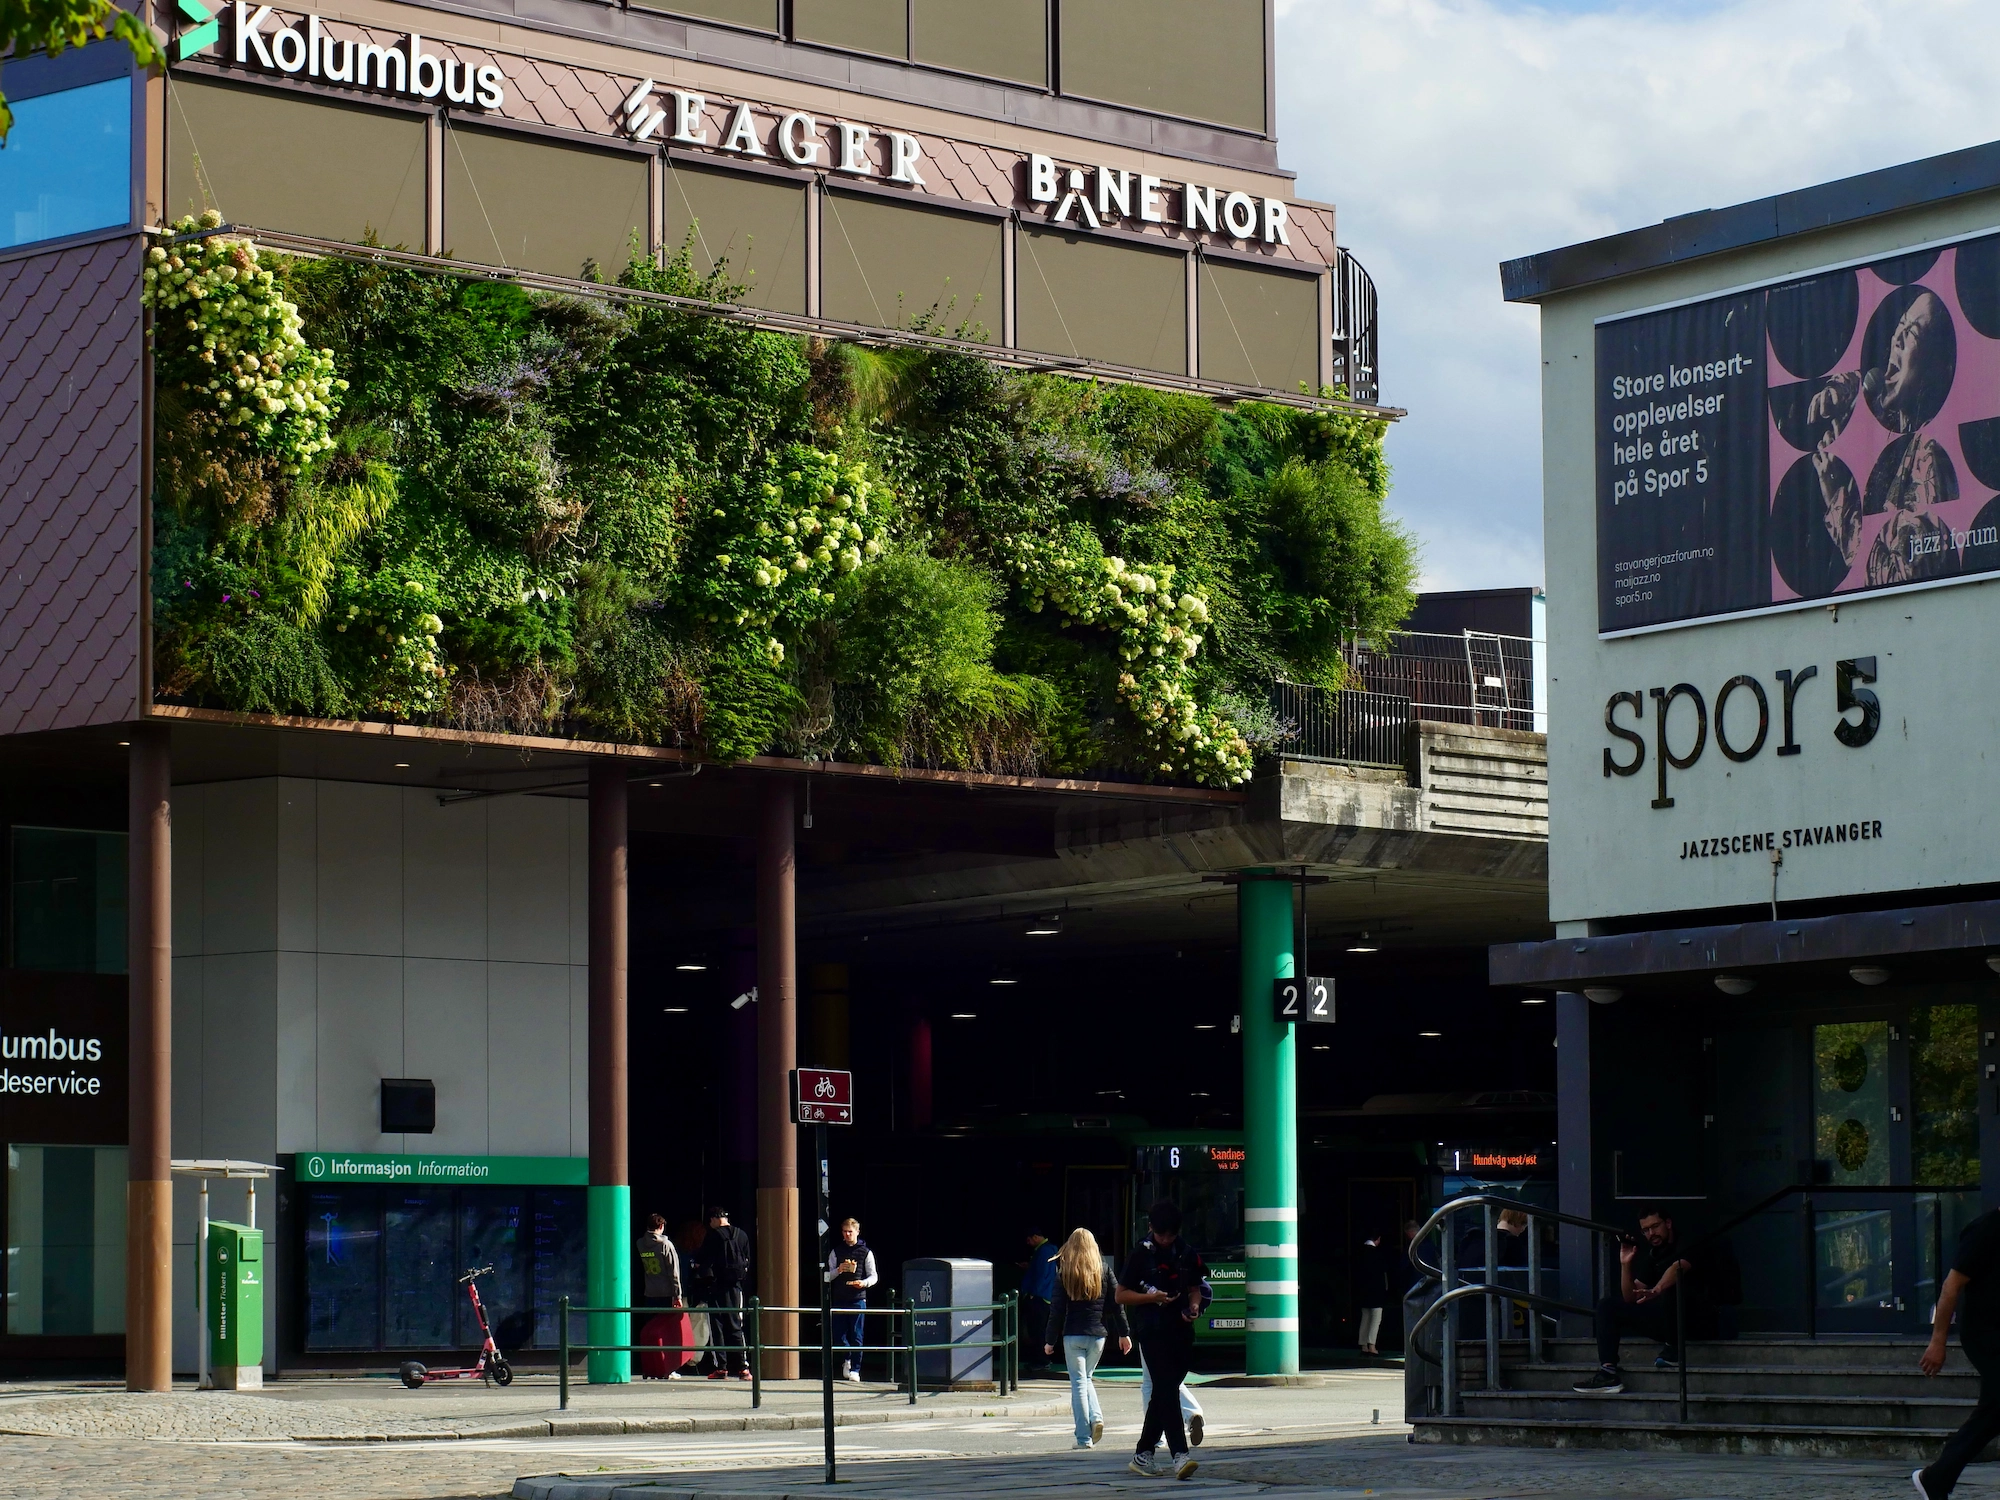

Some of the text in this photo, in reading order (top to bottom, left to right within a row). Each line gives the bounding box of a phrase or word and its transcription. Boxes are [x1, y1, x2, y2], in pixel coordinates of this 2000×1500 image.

[233, 0, 504, 110] Kolumbus
[672, 90, 925, 185] EAGER
[1186, 182, 1290, 246] NOR
[1613, 353, 1753, 400] Store konsert-
[1613, 393, 1725, 437] opplevelser
[1613, 429, 1699, 466] hele året
[1614, 458, 1708, 505] på Spor 5
[1614, 547, 1714, 573] stavangerjazzforum.no
[1615, 572, 1661, 589] maijazz.no
[1615, 590, 1653, 607] spor5.no
[1680, 820, 1883, 860] JAZZSCENE STAVANGER
[1282, 985, 1298, 1015] 2
[1314, 985, 1328, 1015] 2
[0, 1026, 102, 1062] umbus
[0, 1067, 101, 1095] deservice
[1170, 1147, 1180, 1169] 6
[1210, 1147, 1246, 1160] Sandnes
[1218, 1161, 1228, 1169] via
[1454, 1150, 1460, 1171] 1
[1473, 1154, 1537, 1168] Hundvåg vest/øst
[331, 1159, 489, 1179] Informasjon Information
